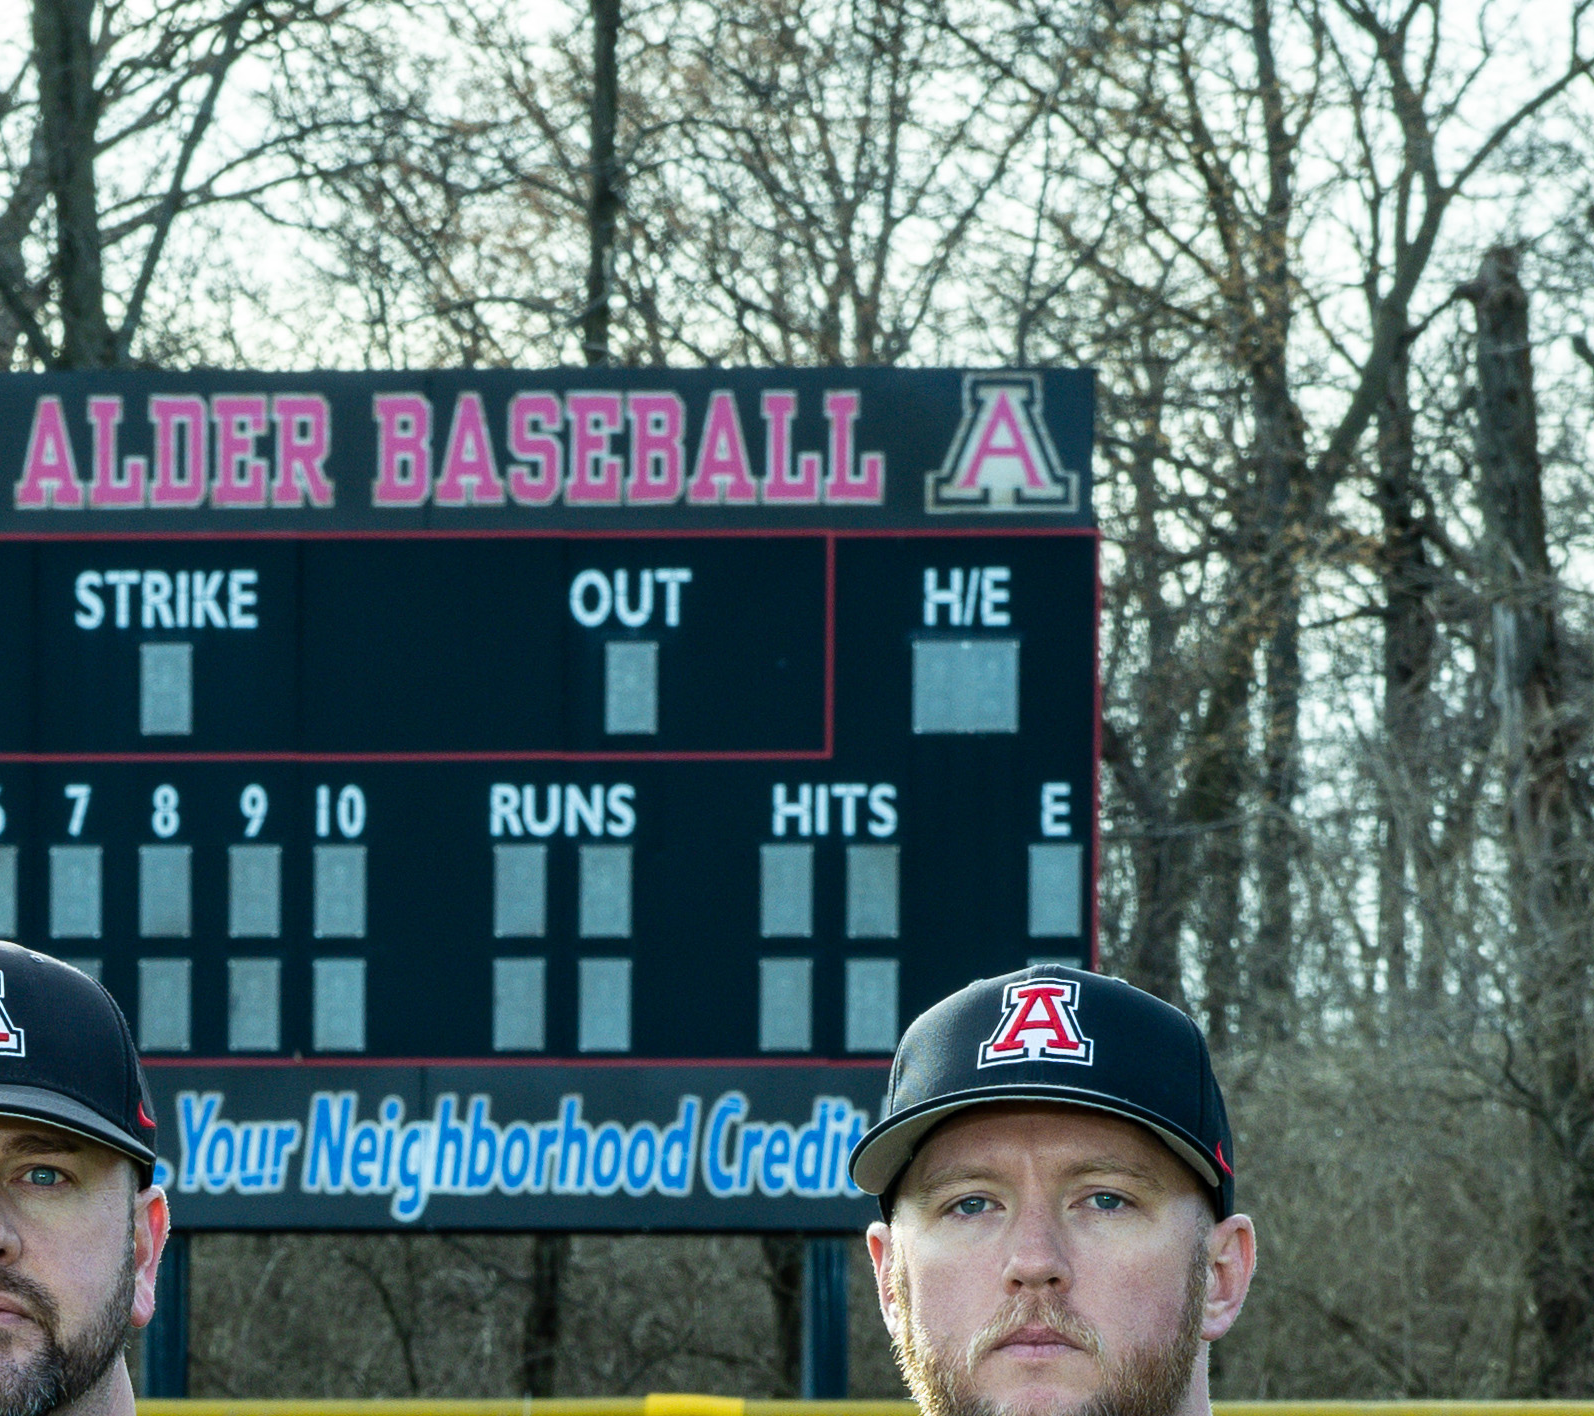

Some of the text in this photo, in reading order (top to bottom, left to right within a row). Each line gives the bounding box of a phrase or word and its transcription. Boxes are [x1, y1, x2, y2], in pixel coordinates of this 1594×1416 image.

[14, 394, 336, 511] ALDER
[371, 389, 886, 508] BASEBALL
[924, 372, 1079, 514] A
[74, 569, 259, 631] STRIKE
[569, 567, 693, 628] OUT
[922, 566, 1011, 627] H/E
[64, 783, 92, 837] 7
[151, 783, 181, 839] 8
[239, 783, 269, 838] 9
[315, 784, 367, 839] 10
[489, 782, 637, 838] RUNS
[771, 782, 898, 838] HITS
[1040, 782, 1072, 838] E
[977, 977, 1095, 1069] A
[176, 1090, 870, 1222] Your Neighborhood Credit
